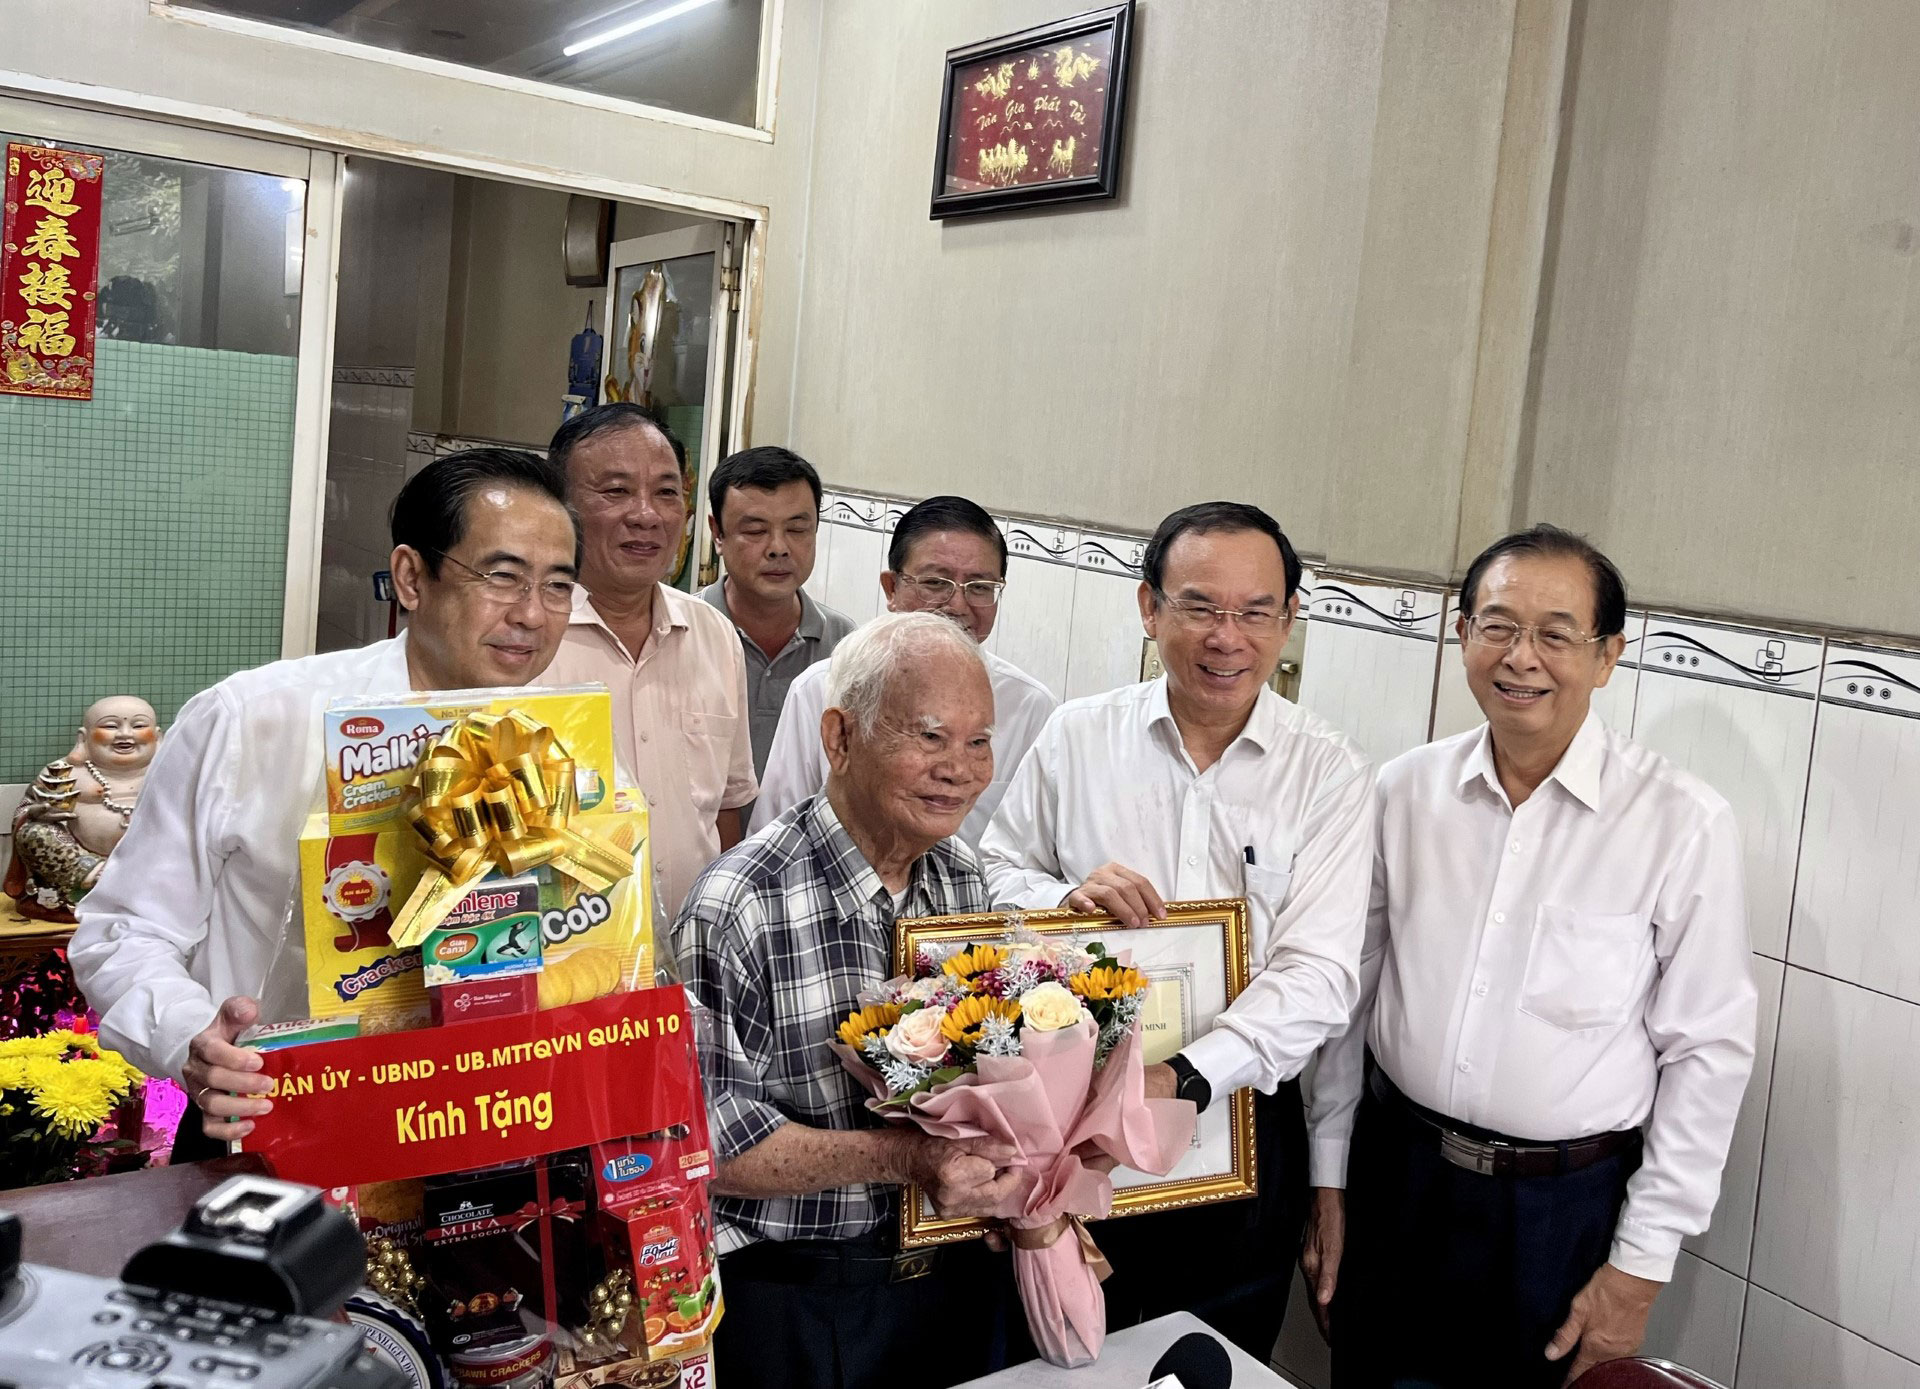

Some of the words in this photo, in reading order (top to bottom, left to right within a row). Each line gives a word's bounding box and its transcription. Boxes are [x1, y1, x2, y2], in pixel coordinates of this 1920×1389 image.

[1005, 100, 1025, 122] Gia
[1034, 95, 1061, 114] Phát
[18, 167, 82, 356] 迎春接福
[346, 724, 379, 734] Roma
[341, 724, 446, 782] Malki
[342, 780, 386, 797] Cream
[343, 787, 400, 809] Crackers
[448, 891, 517, 914] nlene
[440, 945, 467, 955] Canxi
[1145, 1023, 1166, 1031] MINH
[247, 1072, 314, 1101] UẬN
[321, 1066, 351, 1091] ỦY
[372, 1059, 435, 1084] UBND
[456, 1032, 582, 1073] UB.MTTQVN
[588, 1017, 650, 1047] QUẬN
[656, 1014, 680, 1035] 10
[396, 1100, 466, 1144] Kính
[474, 1089, 553, 1138] Tặng
[609, 1159, 618, 1179] 1
[681, 1156, 693, 1166] 20
[441, 1208, 492, 1222] CHOCOLATE
[433, 1236, 468, 1246] EXTRA
[470, 1228, 507, 1239] COCOA
[441, 1219, 500, 1237] MIRA
[490, 1351, 541, 1377] CRACKERS
